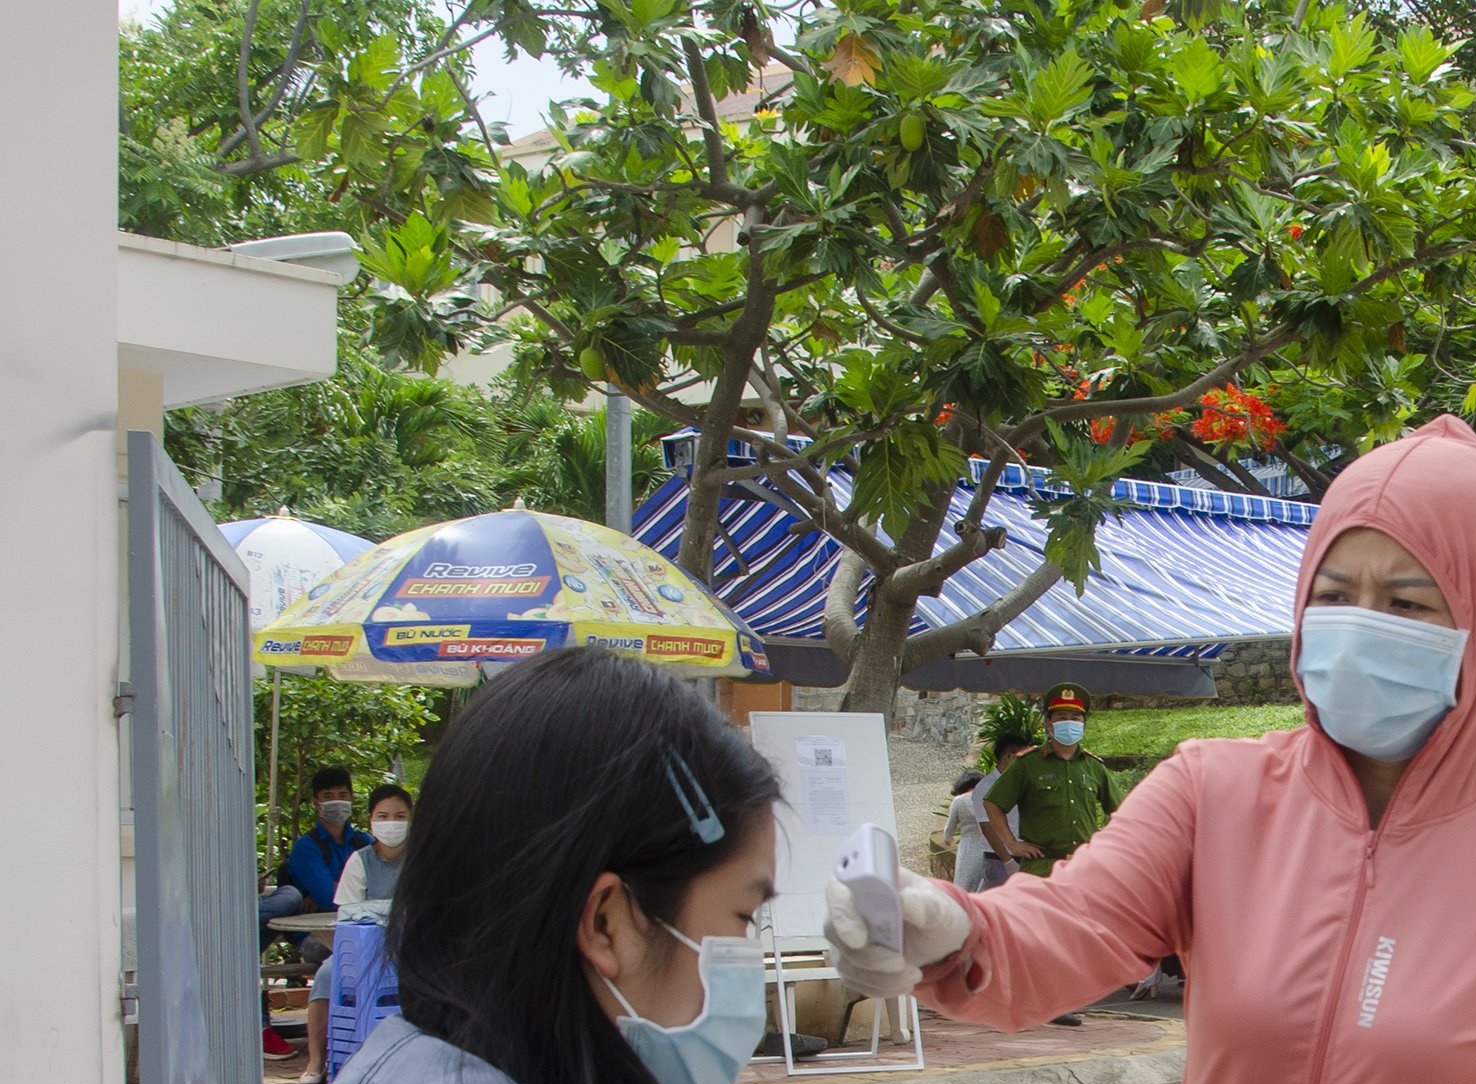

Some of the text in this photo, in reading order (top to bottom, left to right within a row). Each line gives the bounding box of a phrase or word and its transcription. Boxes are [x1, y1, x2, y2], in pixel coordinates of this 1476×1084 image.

[424, 563, 536, 578] Revive
[407, 583, 480, 594] CHANH
[396, 629, 416, 639] BÙ
[260, 640, 301, 652] Revive
[447, 643, 536, 653] BÙ KHOÁNG
[651, 640, 689, 652] CHANH
[1356, 935, 1397, 1029] KIWISUN
